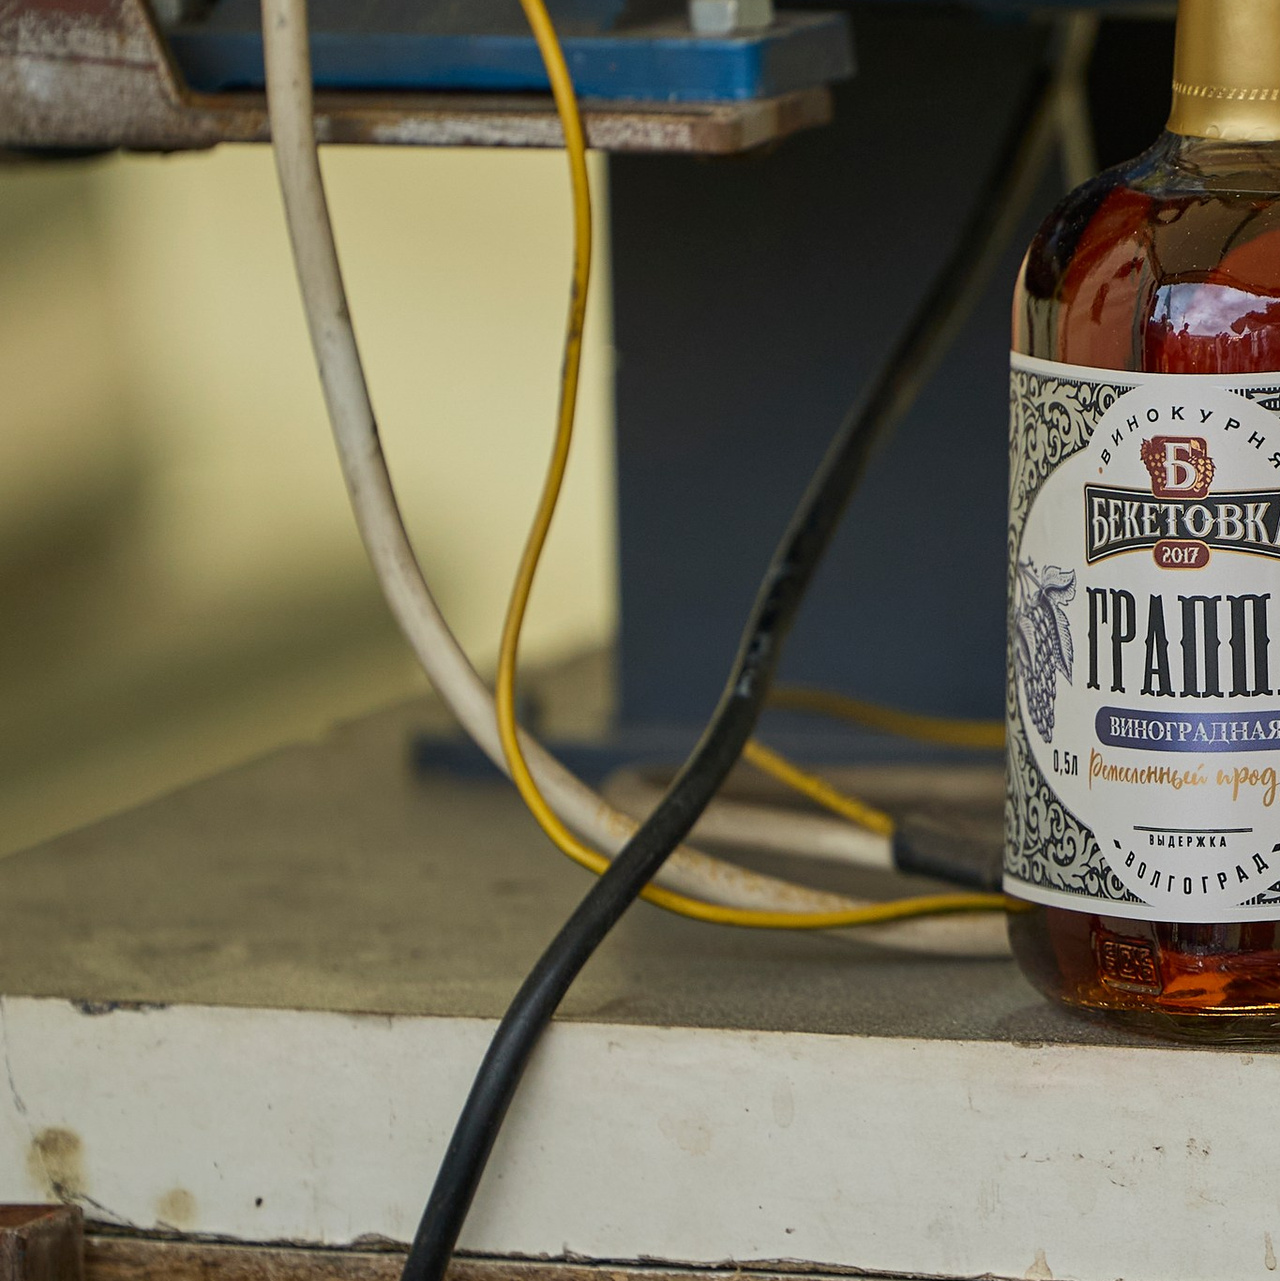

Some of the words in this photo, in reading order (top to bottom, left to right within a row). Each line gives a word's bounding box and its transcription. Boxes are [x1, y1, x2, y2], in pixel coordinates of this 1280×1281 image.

[1162, 441, 1199, 491] Б
[1162, 546, 1200, 564] 2017
[1088, 746, 1208, 791] Ремесленный
[1149, 833, 1228, 848] ВЫДЕРЖКА
[1125, 850, 1269, 895] ВОЛГОГРАД
